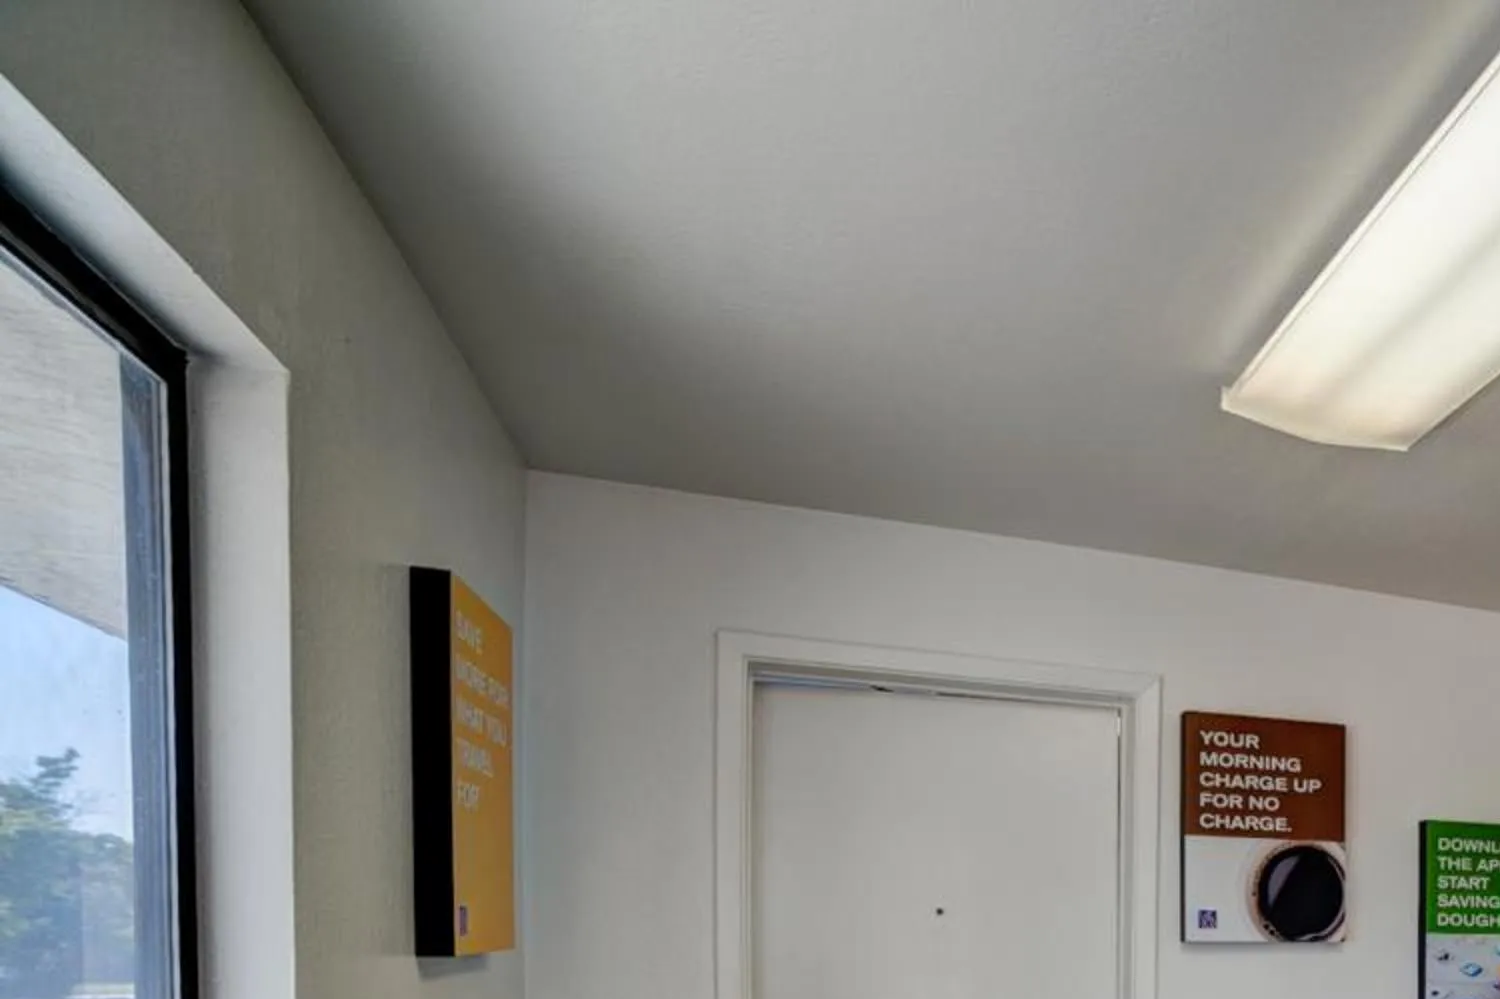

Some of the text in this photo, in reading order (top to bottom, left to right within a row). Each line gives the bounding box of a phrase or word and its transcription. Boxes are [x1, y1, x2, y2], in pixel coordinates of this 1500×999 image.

[1199, 729, 1260, 750] YOUR
[1199, 751, 1302, 773] MORNING
[1199, 771, 1322, 793] CHARGE UP
[1199, 791, 1281, 812] FOR NO
[1199, 812, 1293, 833] CHARGE.
[1437, 856, 1473, 871] THE
[1437, 875, 1491, 891] START
